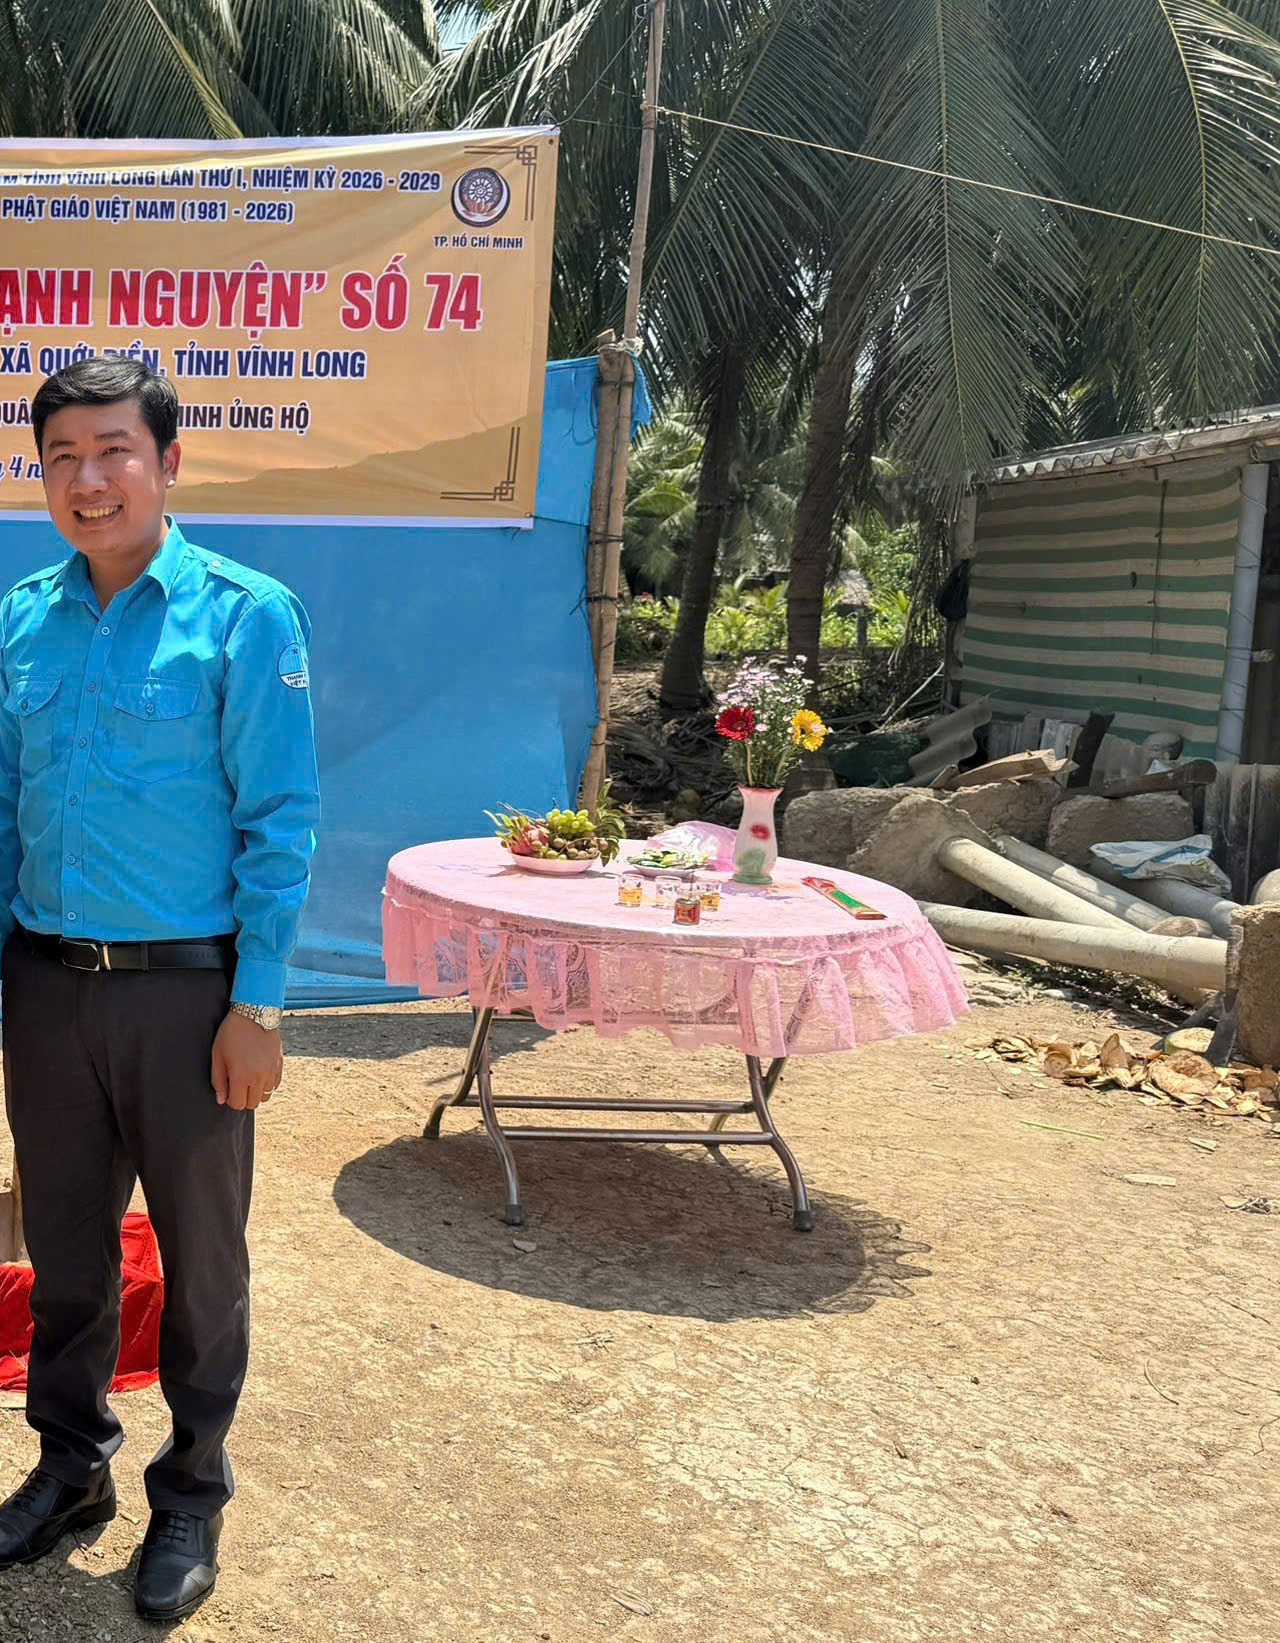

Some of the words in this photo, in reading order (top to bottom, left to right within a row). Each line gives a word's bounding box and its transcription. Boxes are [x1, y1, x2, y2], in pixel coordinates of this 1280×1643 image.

[200, 166, 233, 187] THỨ
[253, 167, 308, 192] NHIỆM
[314, 167, 338, 189] KỲ
[341, 172, 383, 190] 2026
[399, 172, 441, 191] 2029
[3, 195, 45, 222] PHẬT
[51, 195, 89, 218] GIÁO
[96, 196, 131, 223] VIỆT
[135, 200, 175, 219] NAM
[181, 200, 227, 222] (1981
[246, 202, 295, 222] 2026)
[434, 236, 448, 247] TP.
[471, 234, 490, 248] CHÍ
[493, 236, 524, 249] MINH
[341, 254, 409, 331] SỐ
[424, 273, 482, 331] 74
[0, 342, 32, 374] XÃ
[174, 340, 229, 376] TỈNH
[237, 345, 292, 377] VĨNH
[301, 351, 366, 378] LONG
[229, 399, 273, 429] ỦNG
[280, 402, 309, 435] HỘ
[9, 456, 23, 478] 4
